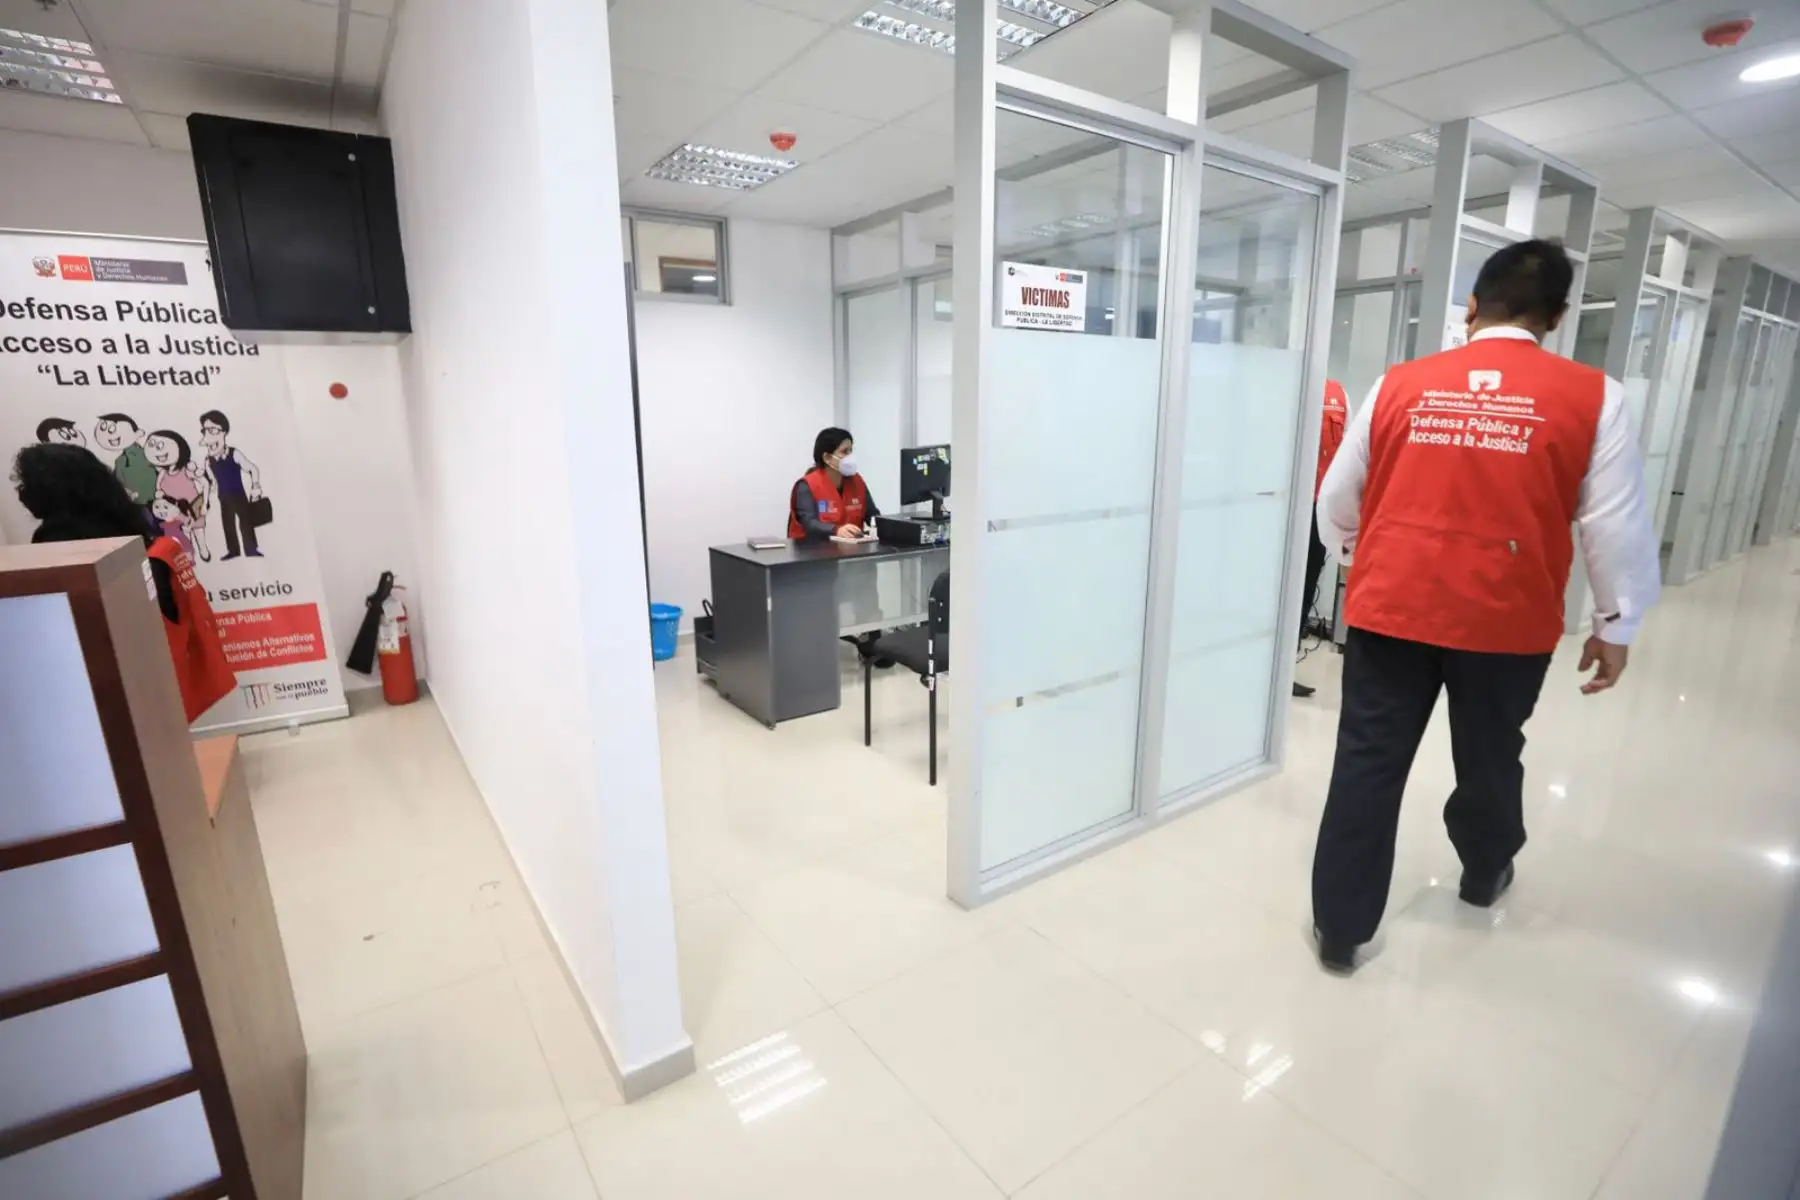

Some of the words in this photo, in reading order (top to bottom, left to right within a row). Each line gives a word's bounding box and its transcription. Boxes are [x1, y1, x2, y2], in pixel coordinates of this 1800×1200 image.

[1021, 287, 1070, 308] VICTIMAS
[115, 300, 218, 324] Pública
[0, 336, 92, 354] cceso
[101, 337, 117, 354] a
[125, 333, 150, 355] la
[159, 334, 260, 356] Justicia
[1423, 390, 1475, 400] Ministerio
[1477, 392, 1491, 401] de
[1492, 394, 1535, 405] Justicia
[1428, 399, 1478, 409] Derechos
[1482, 402, 1535, 414] Humanos
[1410, 415, 1464, 430] Defensa
[1467, 416, 1519, 436] Pública
[1524, 426, 1533, 440] y
[1408, 429, 1451, 444] Acceso
[1452, 434, 1461, 446] a
[1464, 432, 1475, 447] la
[1477, 433, 1529, 455] Justicia
[219, 580, 293, 601] servicio
[263, 633, 315, 646] Alternativos
[226, 651, 254, 663] lución
[273, 678, 327, 693] Siempre
